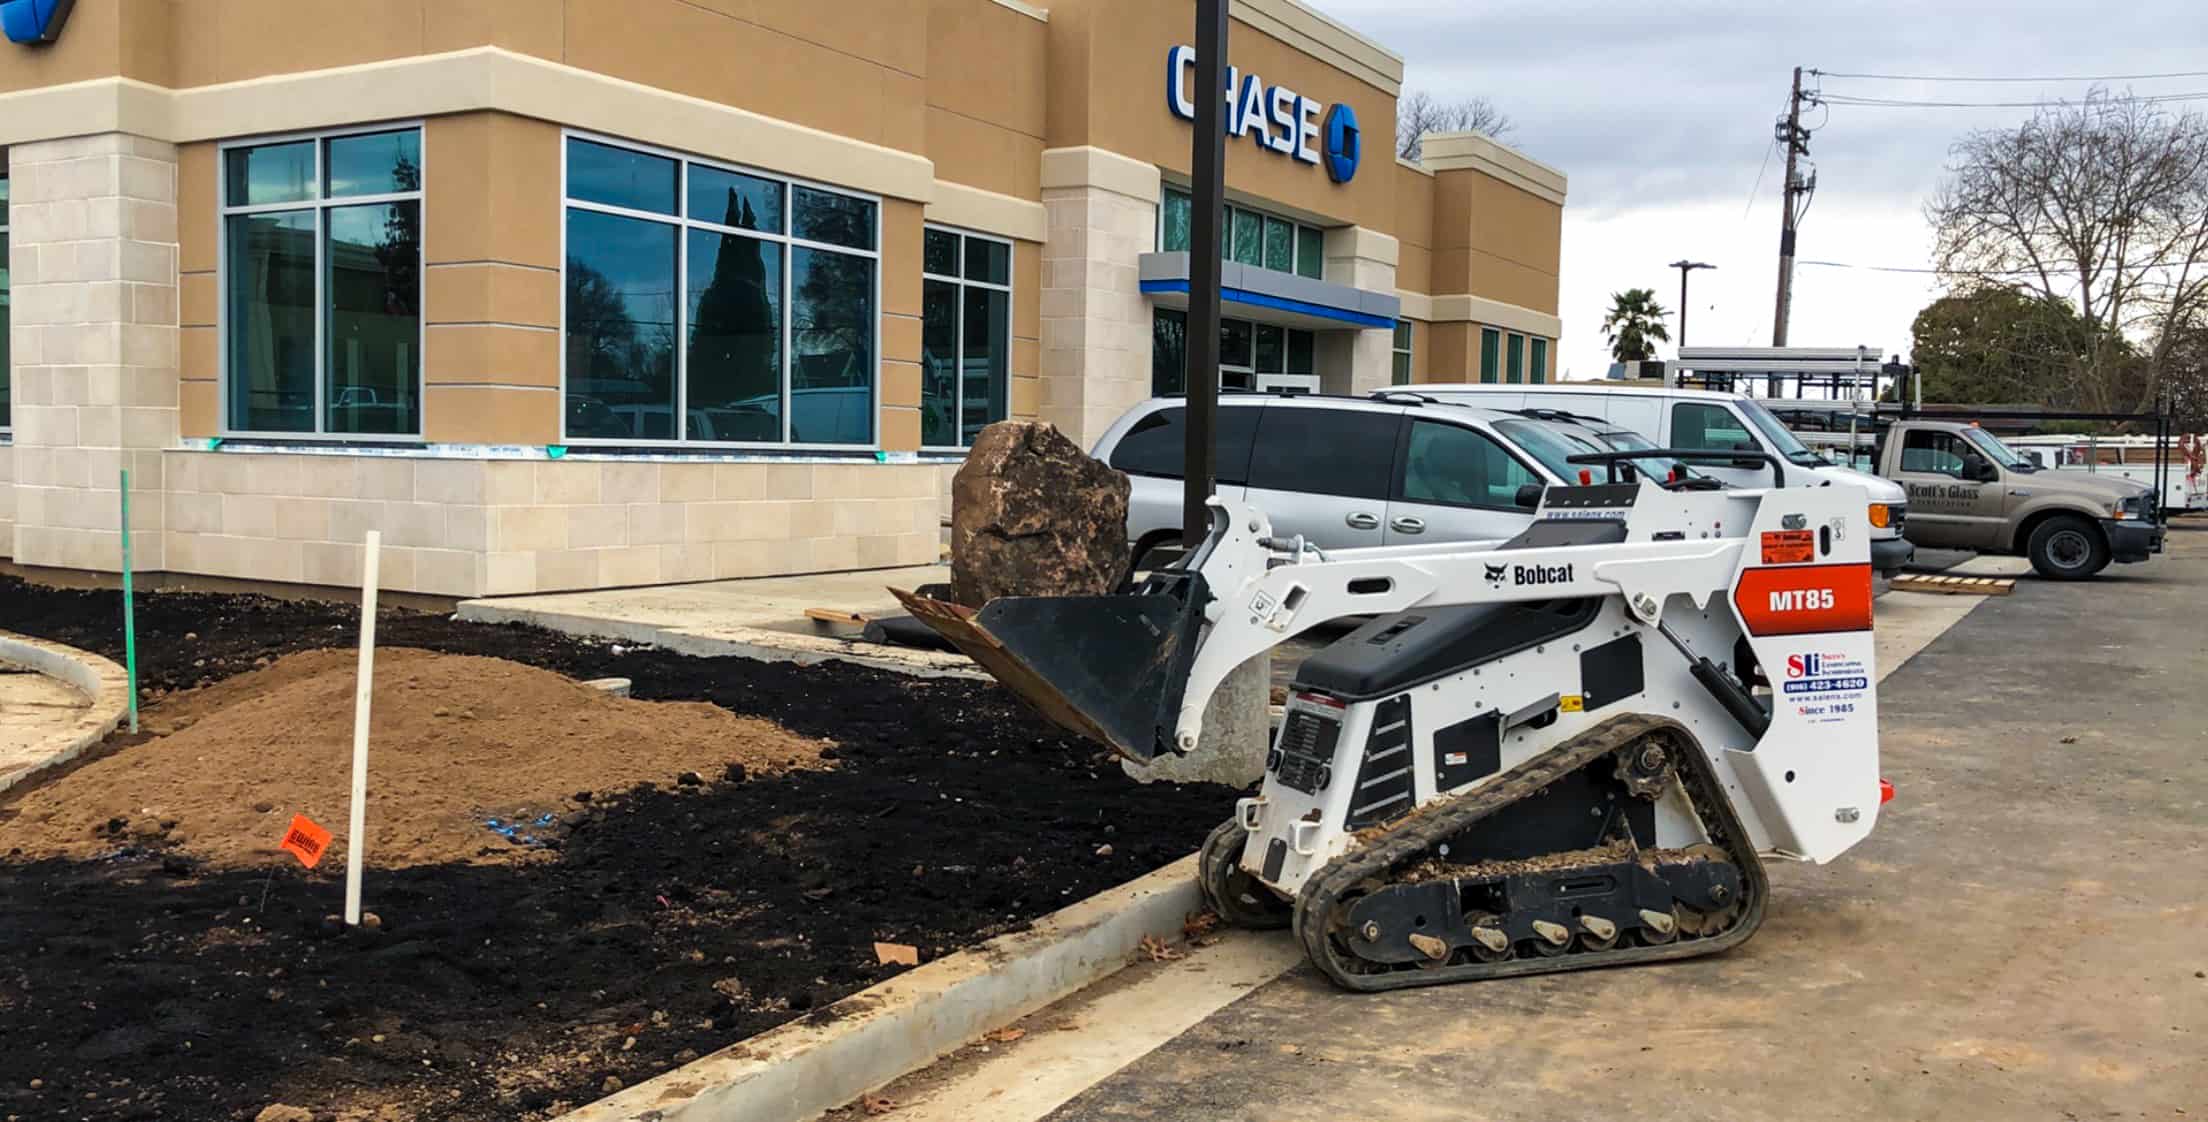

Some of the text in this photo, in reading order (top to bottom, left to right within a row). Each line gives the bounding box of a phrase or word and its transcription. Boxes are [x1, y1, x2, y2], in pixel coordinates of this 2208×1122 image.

[1947, 485, 1980, 500] Glass
[1514, 563, 1574, 585] Bobcat
[1769, 589, 1835, 611] MT85
[1798, 703, 1854, 716] Since 1985
